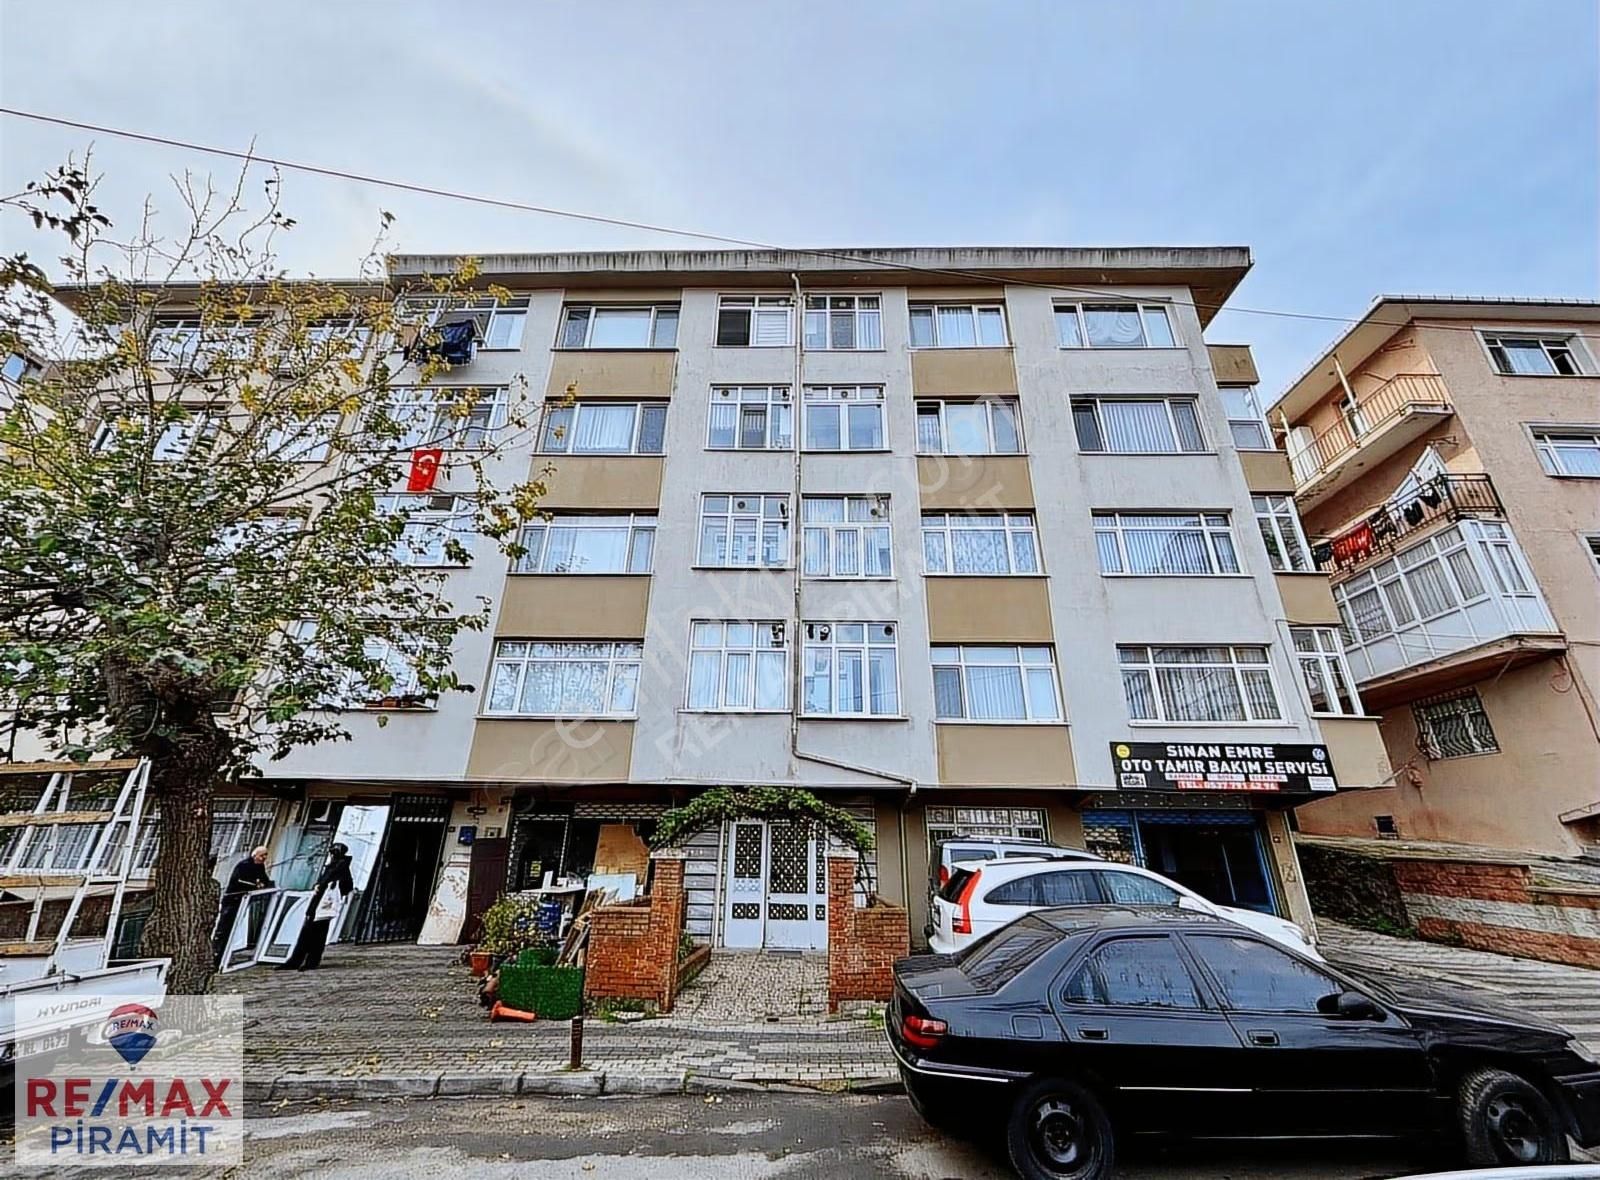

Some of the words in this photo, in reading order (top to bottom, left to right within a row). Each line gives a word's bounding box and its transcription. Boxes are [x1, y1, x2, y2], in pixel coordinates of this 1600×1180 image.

[1226, 746, 1275, 759] EMRE
[1121, 759, 1152, 772] OTO
[1208, 761, 1261, 774] BAKIM
[37, 997, 102, 1018] HYUNDAI
